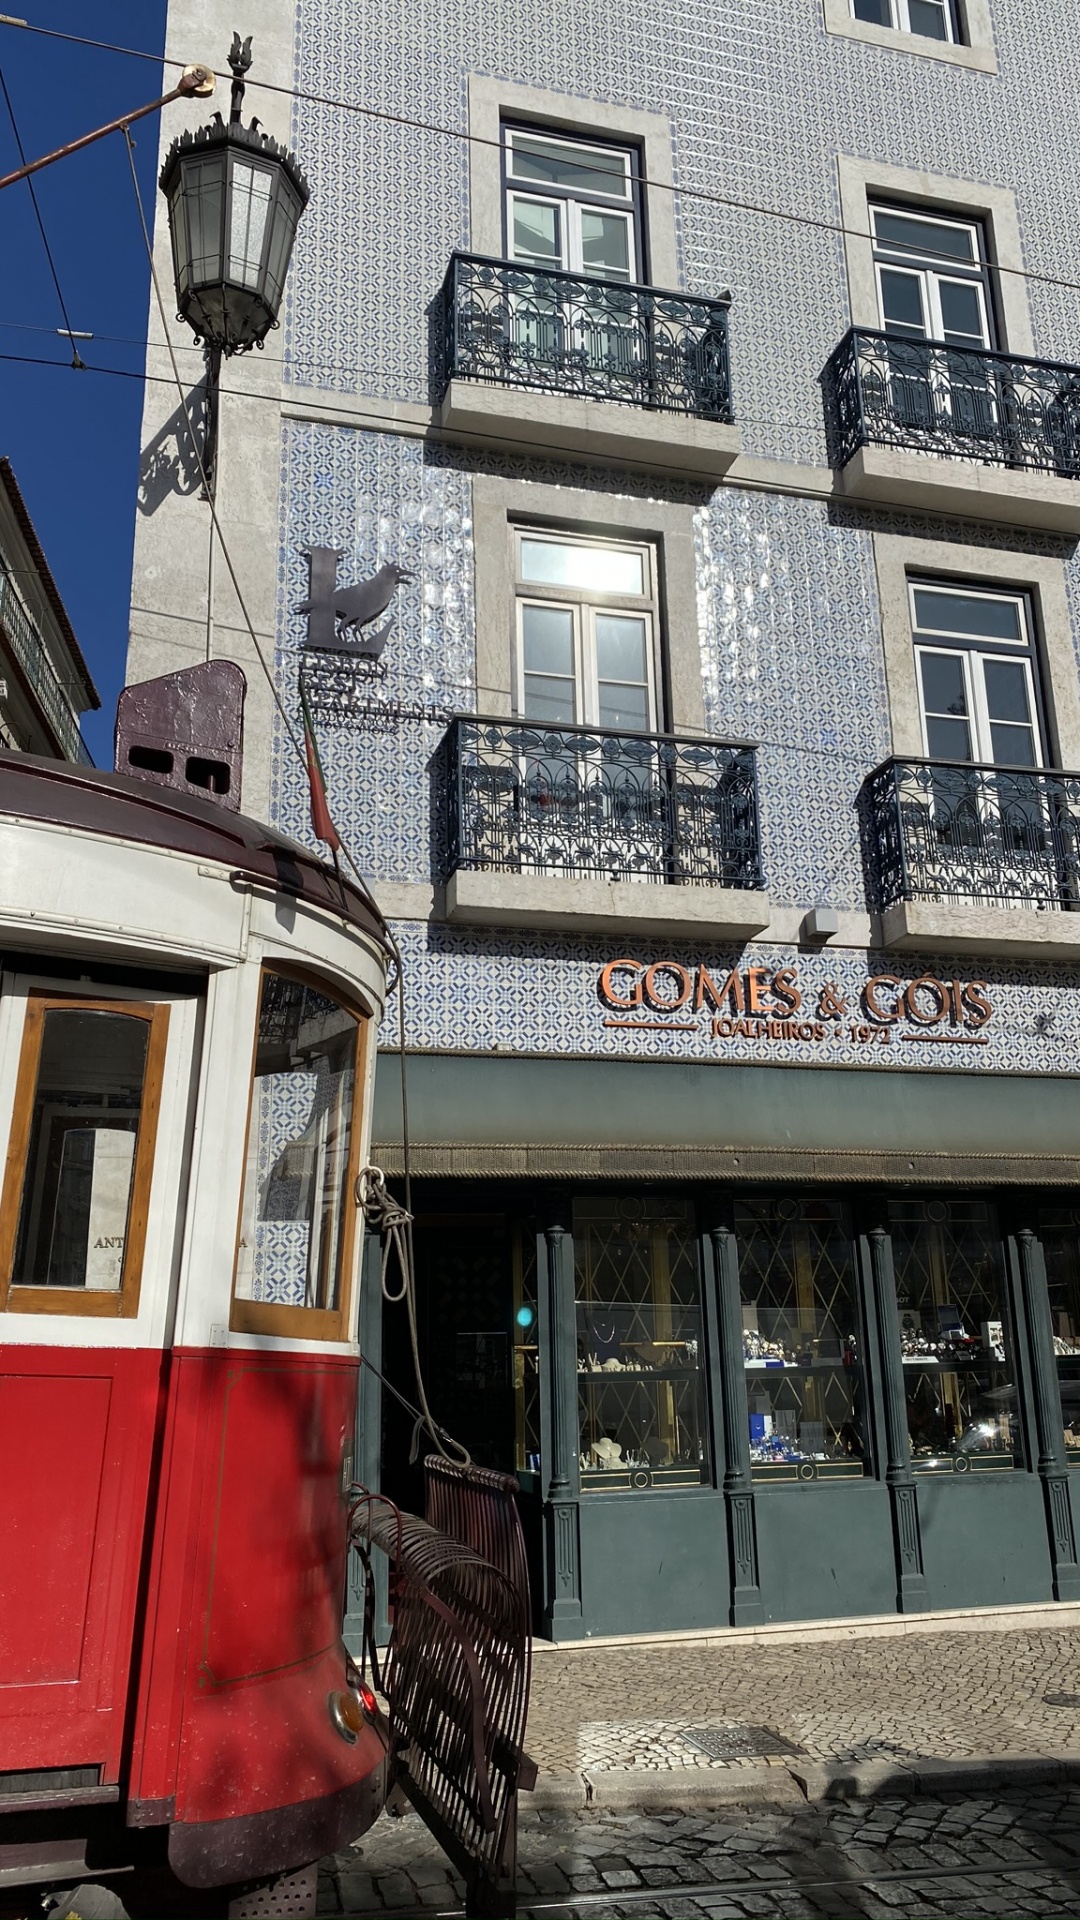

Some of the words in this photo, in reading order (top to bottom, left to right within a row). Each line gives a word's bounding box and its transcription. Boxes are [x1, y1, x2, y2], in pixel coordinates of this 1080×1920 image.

[302, 652, 389, 679] LISBON
[602, 959, 801, 1014] GOMES
[820, 982, 848, 1015] &
[866, 971, 992, 1024] GÓIS
[712, 1018, 826, 1042] JOALHEIROS
[850, 1026, 891, 1045] 1972
